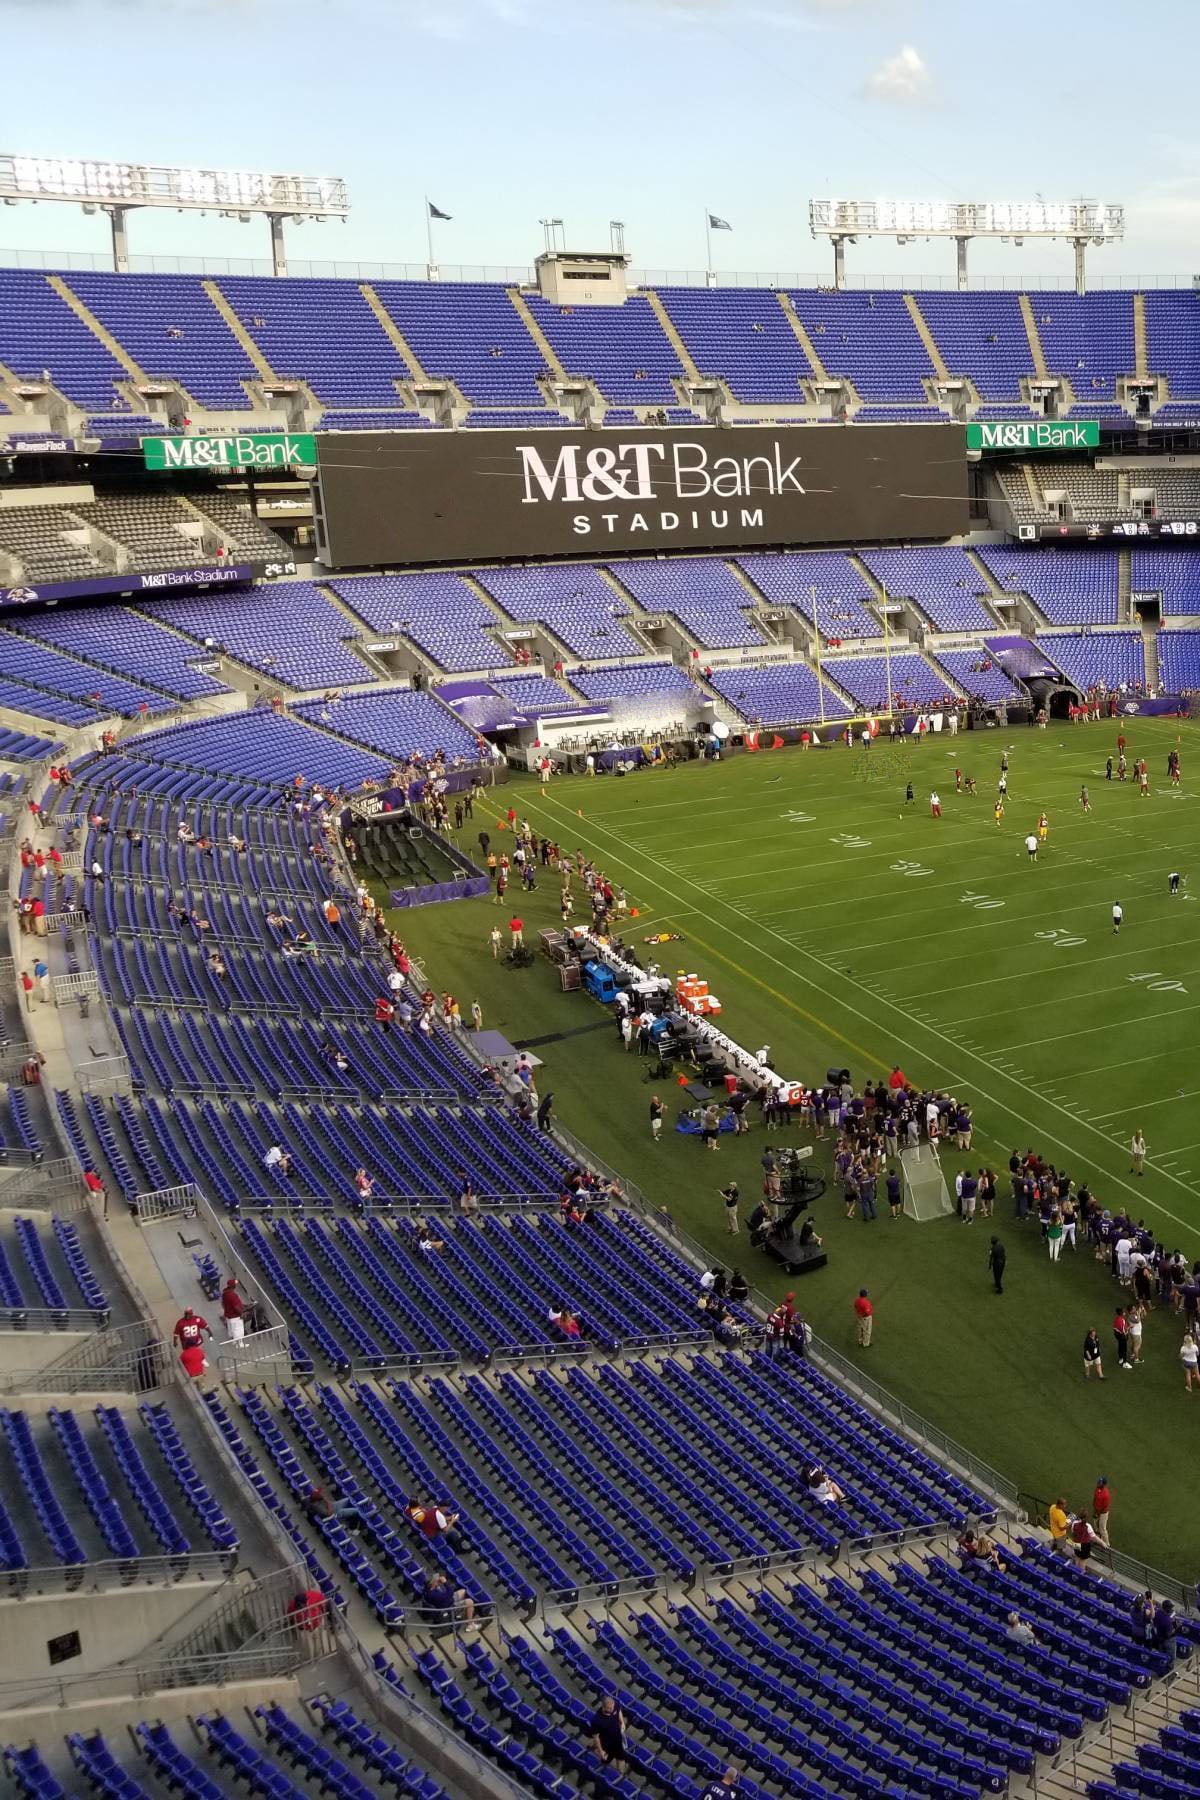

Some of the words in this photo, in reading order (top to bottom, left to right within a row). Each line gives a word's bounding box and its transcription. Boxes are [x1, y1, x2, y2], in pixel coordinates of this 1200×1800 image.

[981, 424, 1034, 446] M&T
[1036, 424, 1087, 445] Bank
[164, 438, 234, 467] M&T
[235, 437, 302, 464] Bank
[515, 443, 664, 503] M&T
[673, 441, 806, 498] Bank
[572, 508, 764, 534] STADIUM
[141, 575, 167, 587] M&T
[168, 572, 194, 585] Bank
[194, 569, 238, 582] Stadium
[265, 563, 297, 576] 29:19
[889, 860, 935, 877] 30
[1033, 928, 1088, 947] 50
[1126, 972, 1184, 990] 40
[182, 1325, 198, 1337] 28
